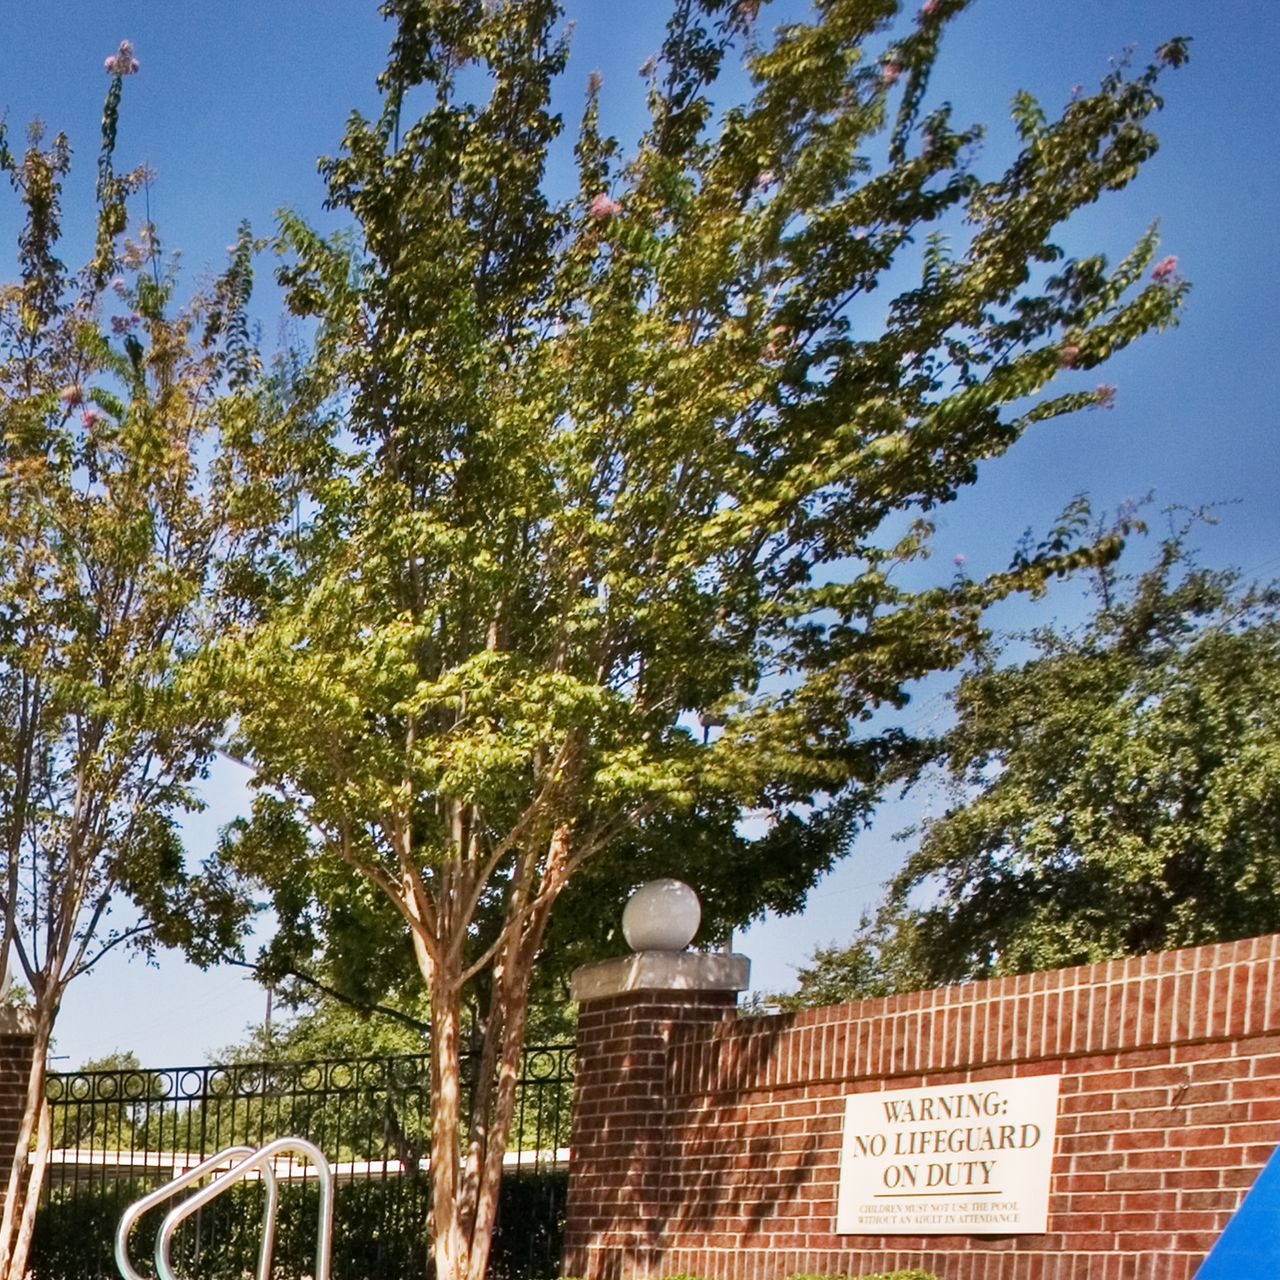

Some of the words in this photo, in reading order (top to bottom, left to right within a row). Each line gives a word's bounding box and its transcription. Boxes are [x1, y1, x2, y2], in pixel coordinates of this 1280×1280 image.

[883, 1091, 1008, 1123] WARNING:
[853, 1134, 887, 1158] NO
[893, 1123, 1041, 1156] LIFEGUARD
[883, 1164, 919, 1188] ON
[926, 1160, 997, 1187] DUTY
[858, 1215, 897, 1225] WITHOUT
[900, 1215, 911, 1225] AN
[915, 1215, 942, 1225] ADULT
[945, 1214, 955, 1223] IN
[959, 1213, 1021, 1224] ATTENDANCE
[859, 1204, 902, 1213] CHILDREN
[905, 1203, 929, 1213] MUST
[931, 1203, 949, 1213] NOT
[952, 1202, 968, 1212] USE
[972, 1202, 988, 1212] THE
[992, 1201, 1019, 1211] POOL
